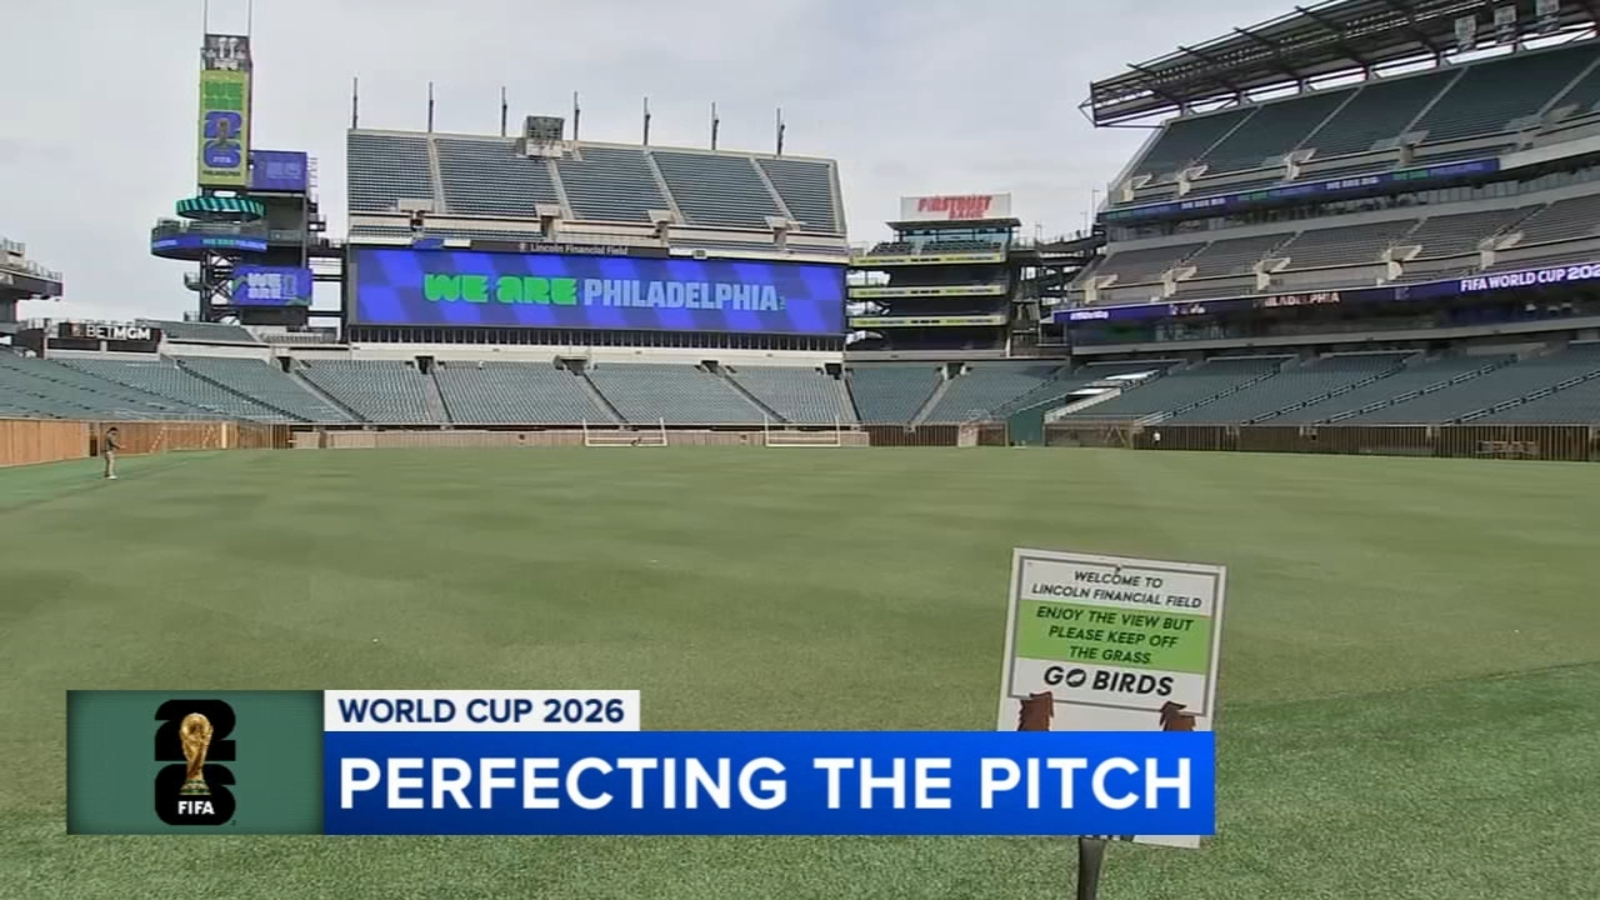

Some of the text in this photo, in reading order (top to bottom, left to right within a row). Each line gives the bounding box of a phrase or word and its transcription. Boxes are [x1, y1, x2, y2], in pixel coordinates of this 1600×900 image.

[531, 243, 628, 255] Lincoln Financial Field
[1461, 279, 1488, 292] FIFA
[1489, 272, 1536, 288] WORLD
[1538, 269, 1566, 283] CUP
[425, 274, 489, 303] WE
[496, 276, 577, 305] ARE
[584, 279, 779, 311] PHILADELPHIA
[1253, 292, 1341, 309] HILADELPHIA
[86, 325, 151, 340] BETMGM
[1074, 570, 1163, 589] WELCOME TO
[1032, 583, 1202, 609] LINCOLN FINANCIAL FIELD
[1036, 606, 1194, 632] ENJOY THE VIEW BUT
[1049, 626, 1179, 649] PLEASE KEEP OFF
[1069, 646, 1097, 660] THE
[1043, 666, 1174, 697] GO BIRDS
